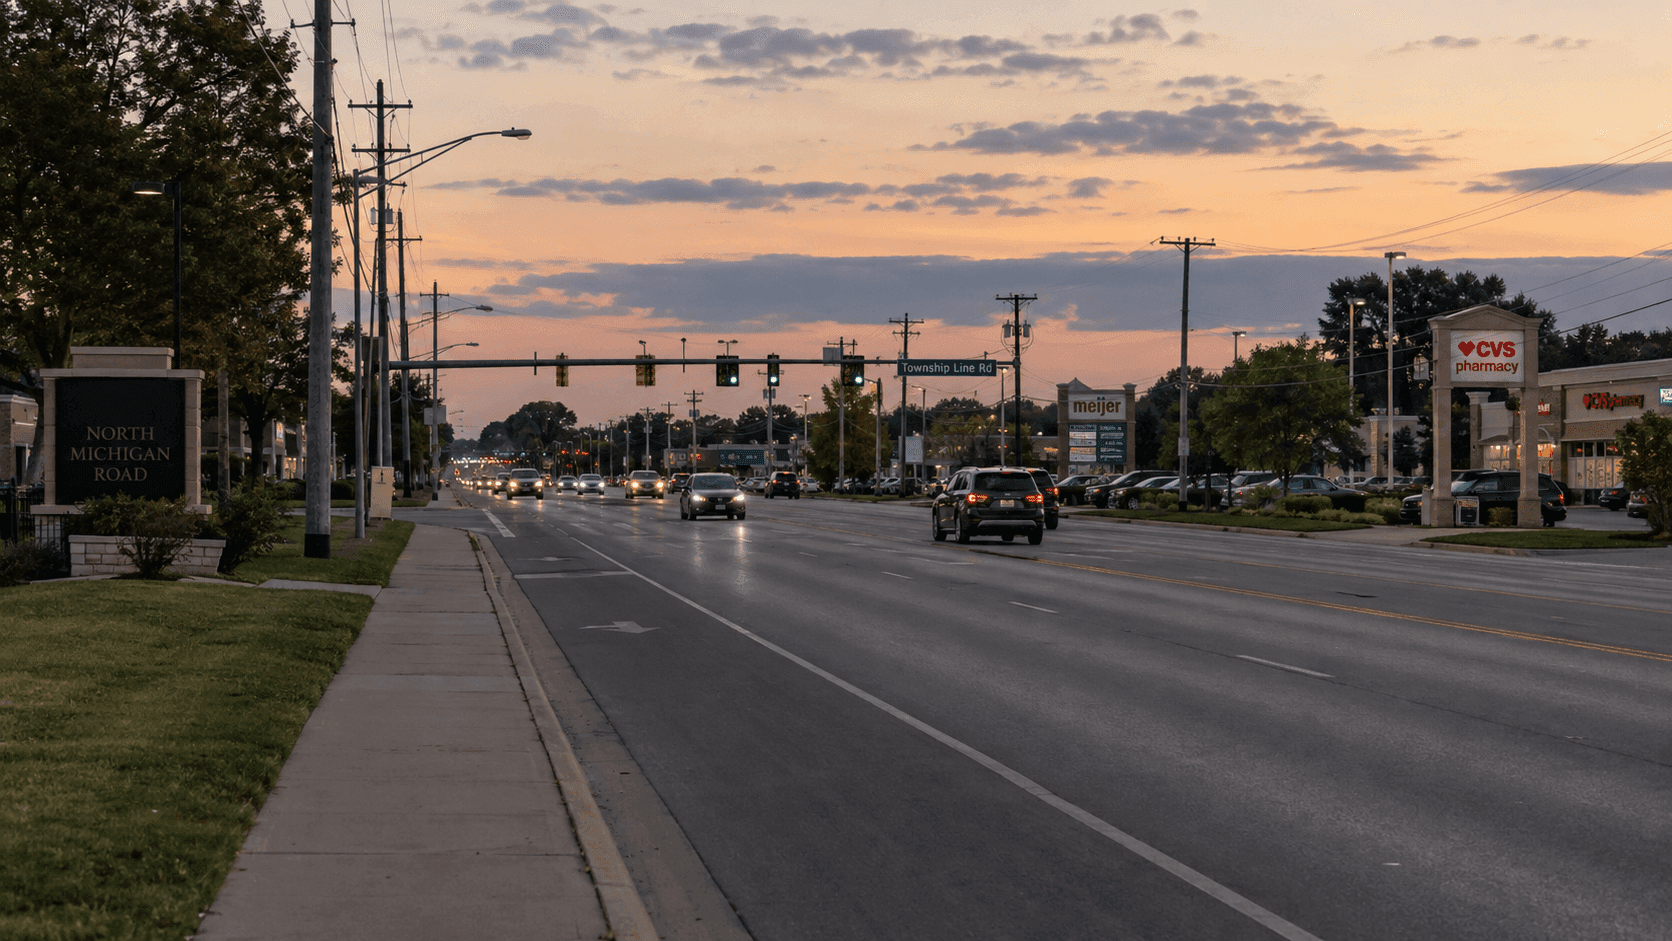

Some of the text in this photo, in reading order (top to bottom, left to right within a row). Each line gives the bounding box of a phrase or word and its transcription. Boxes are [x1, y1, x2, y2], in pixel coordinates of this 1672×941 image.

[1476, 340, 1516, 358] CVS
[901, 362, 993, 374] Township Line Rd
[1456, 359, 1519, 375] pharmacy
[1073, 396, 1122, 416] meijer
[87, 426, 154, 440] NORTH
[70, 446, 170, 461] MICHIGAN
[94, 467, 148, 481] ROAD
